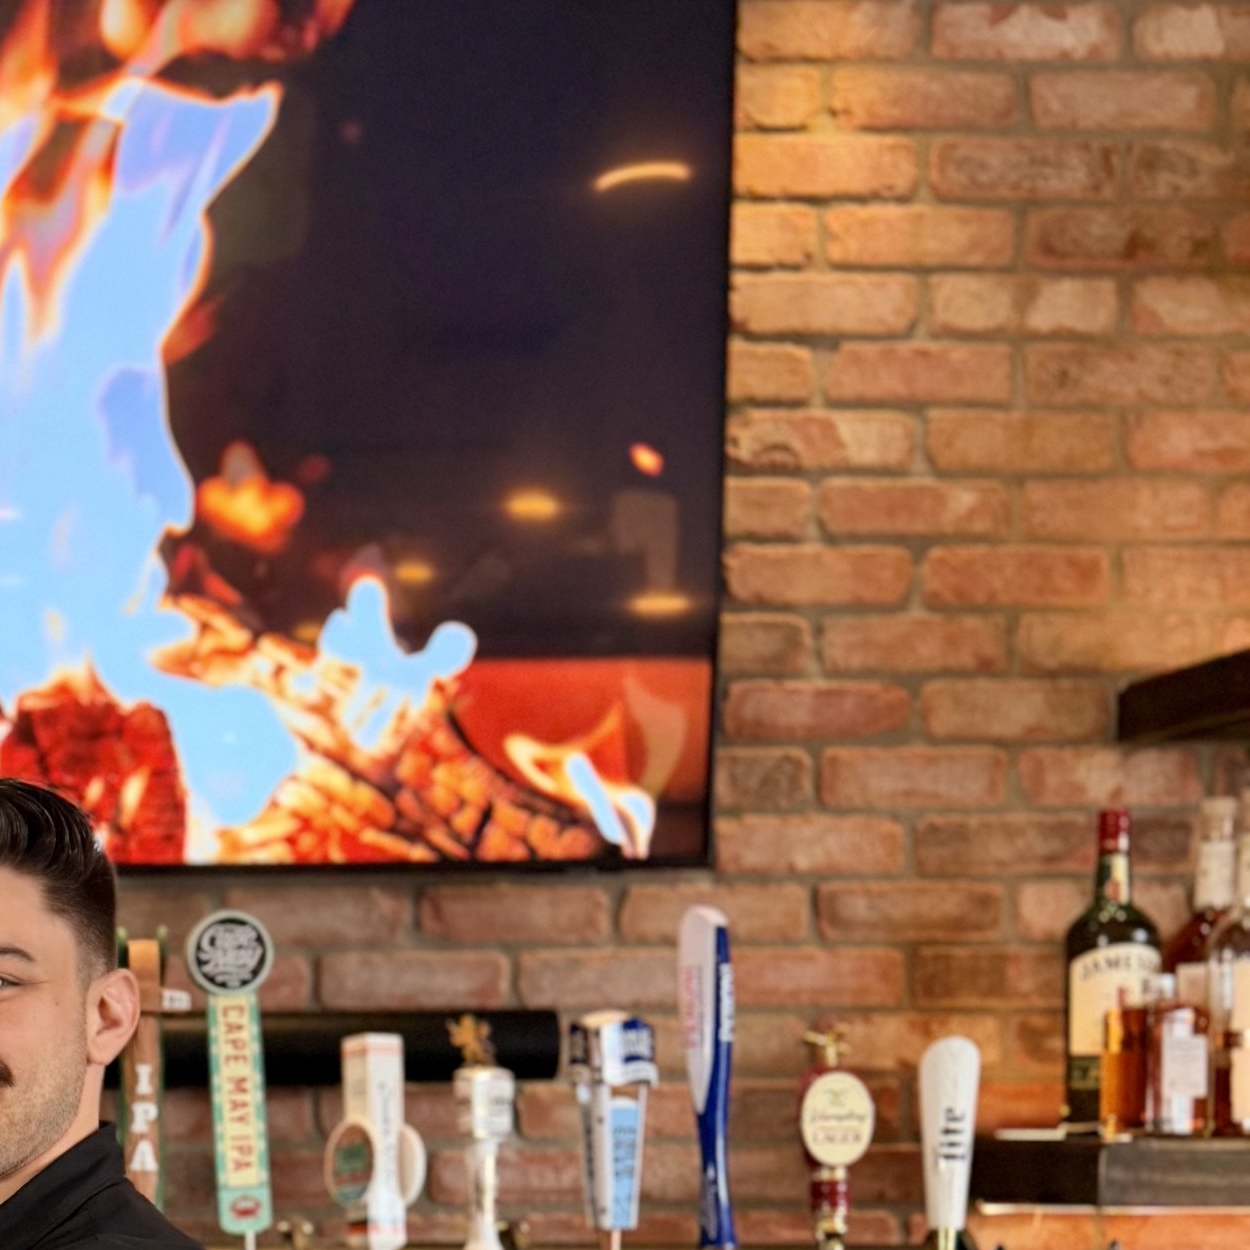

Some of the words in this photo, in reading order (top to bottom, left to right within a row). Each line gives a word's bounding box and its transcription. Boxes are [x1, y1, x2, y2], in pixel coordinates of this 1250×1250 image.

[222, 1004, 247, 1066] CAPE
[129, 1064, 159, 1172] IPA
[227, 1076, 250, 1127] MAY
[230, 1134, 254, 1173] IPA
